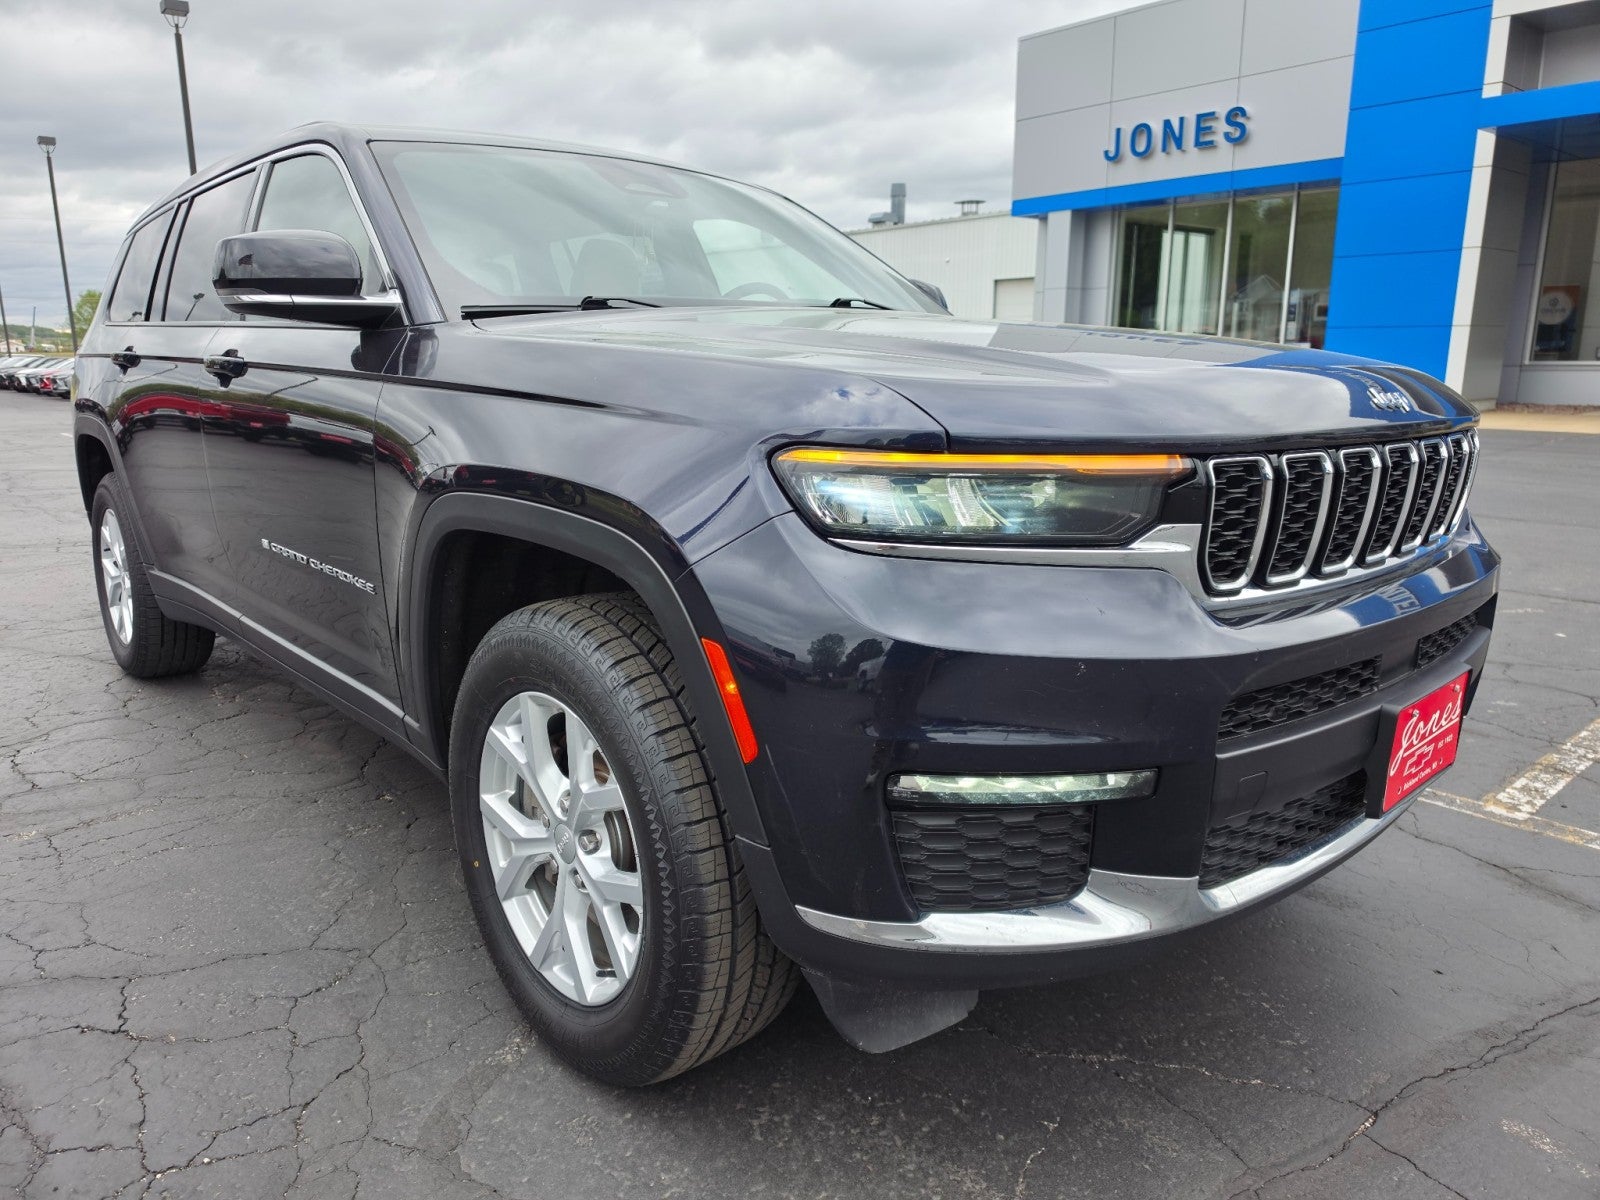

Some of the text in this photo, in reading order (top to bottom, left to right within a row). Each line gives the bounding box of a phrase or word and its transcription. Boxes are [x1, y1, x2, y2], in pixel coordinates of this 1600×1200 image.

[1103, 106, 1248, 162] JONES
[1367, 387, 1410, 413] Jeep
[271, 542, 376, 595] GRAND CHEROKEE
[1390, 691, 1462, 777] Jones
